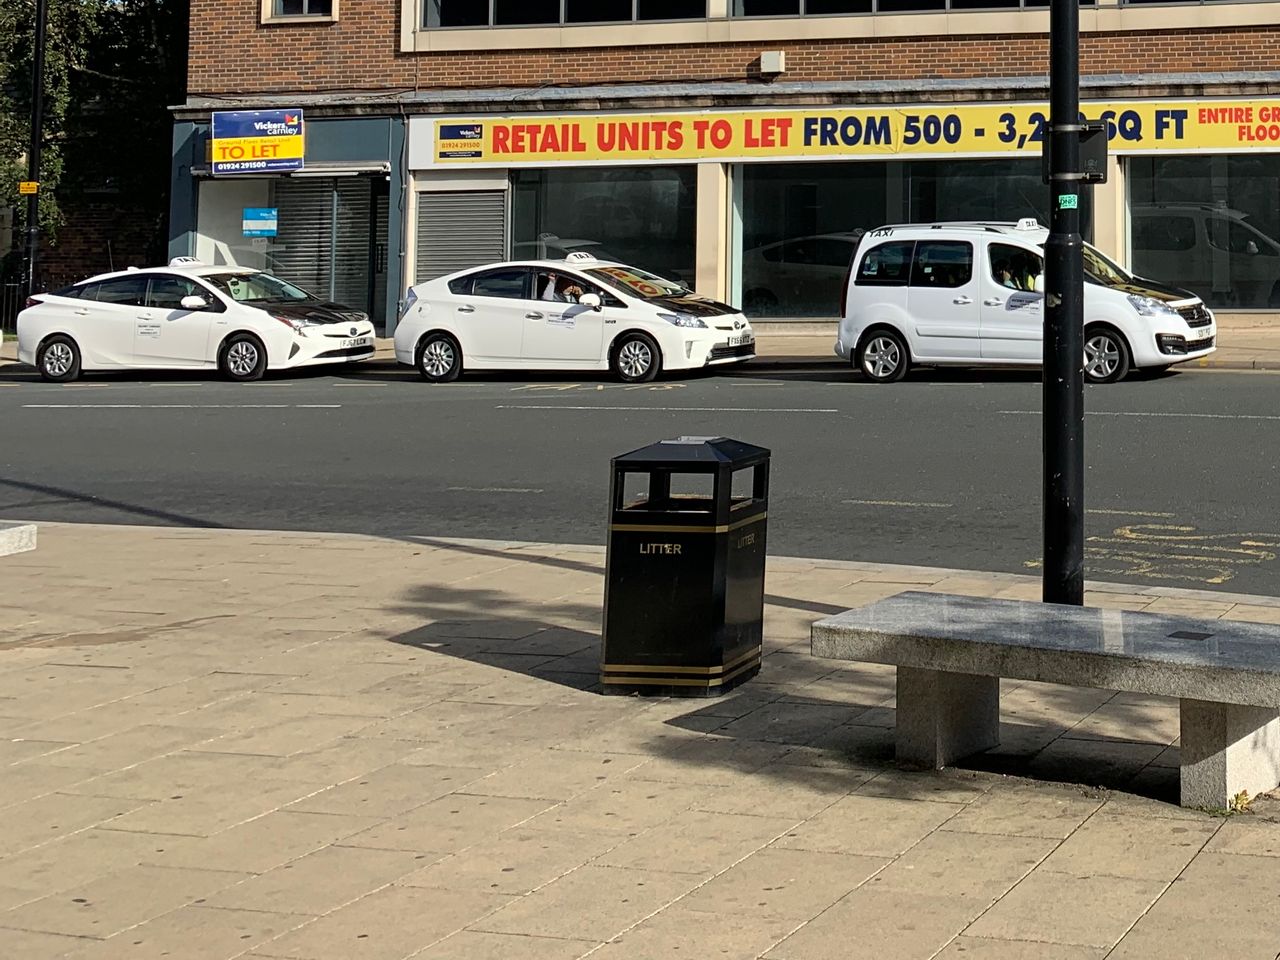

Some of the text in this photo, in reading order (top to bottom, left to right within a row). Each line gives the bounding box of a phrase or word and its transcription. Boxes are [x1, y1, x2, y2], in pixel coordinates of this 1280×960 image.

[1198, 106, 1253, 124] ENTIRE
[254, 121, 286, 130] Vickers
[492, 123, 586, 153] RETAIL
[597, 121, 684, 152] UNITS
[693, 119, 732, 150] TO
[744, 118, 792, 148] LET
[803, 116, 892, 146] FROM
[902, 114, 962, 145] 500
[974, 128, 985, 137] -
[1155, 110, 1188, 139] FT
[218, 144, 280, 159] TO LET
[218, 162, 240, 170] 01924
[240, 161, 266, 169] 291500
[869, 229, 894, 238] TAXI
[737, 533, 755, 549] LITTER
[639, 543, 682, 554] LITTER
